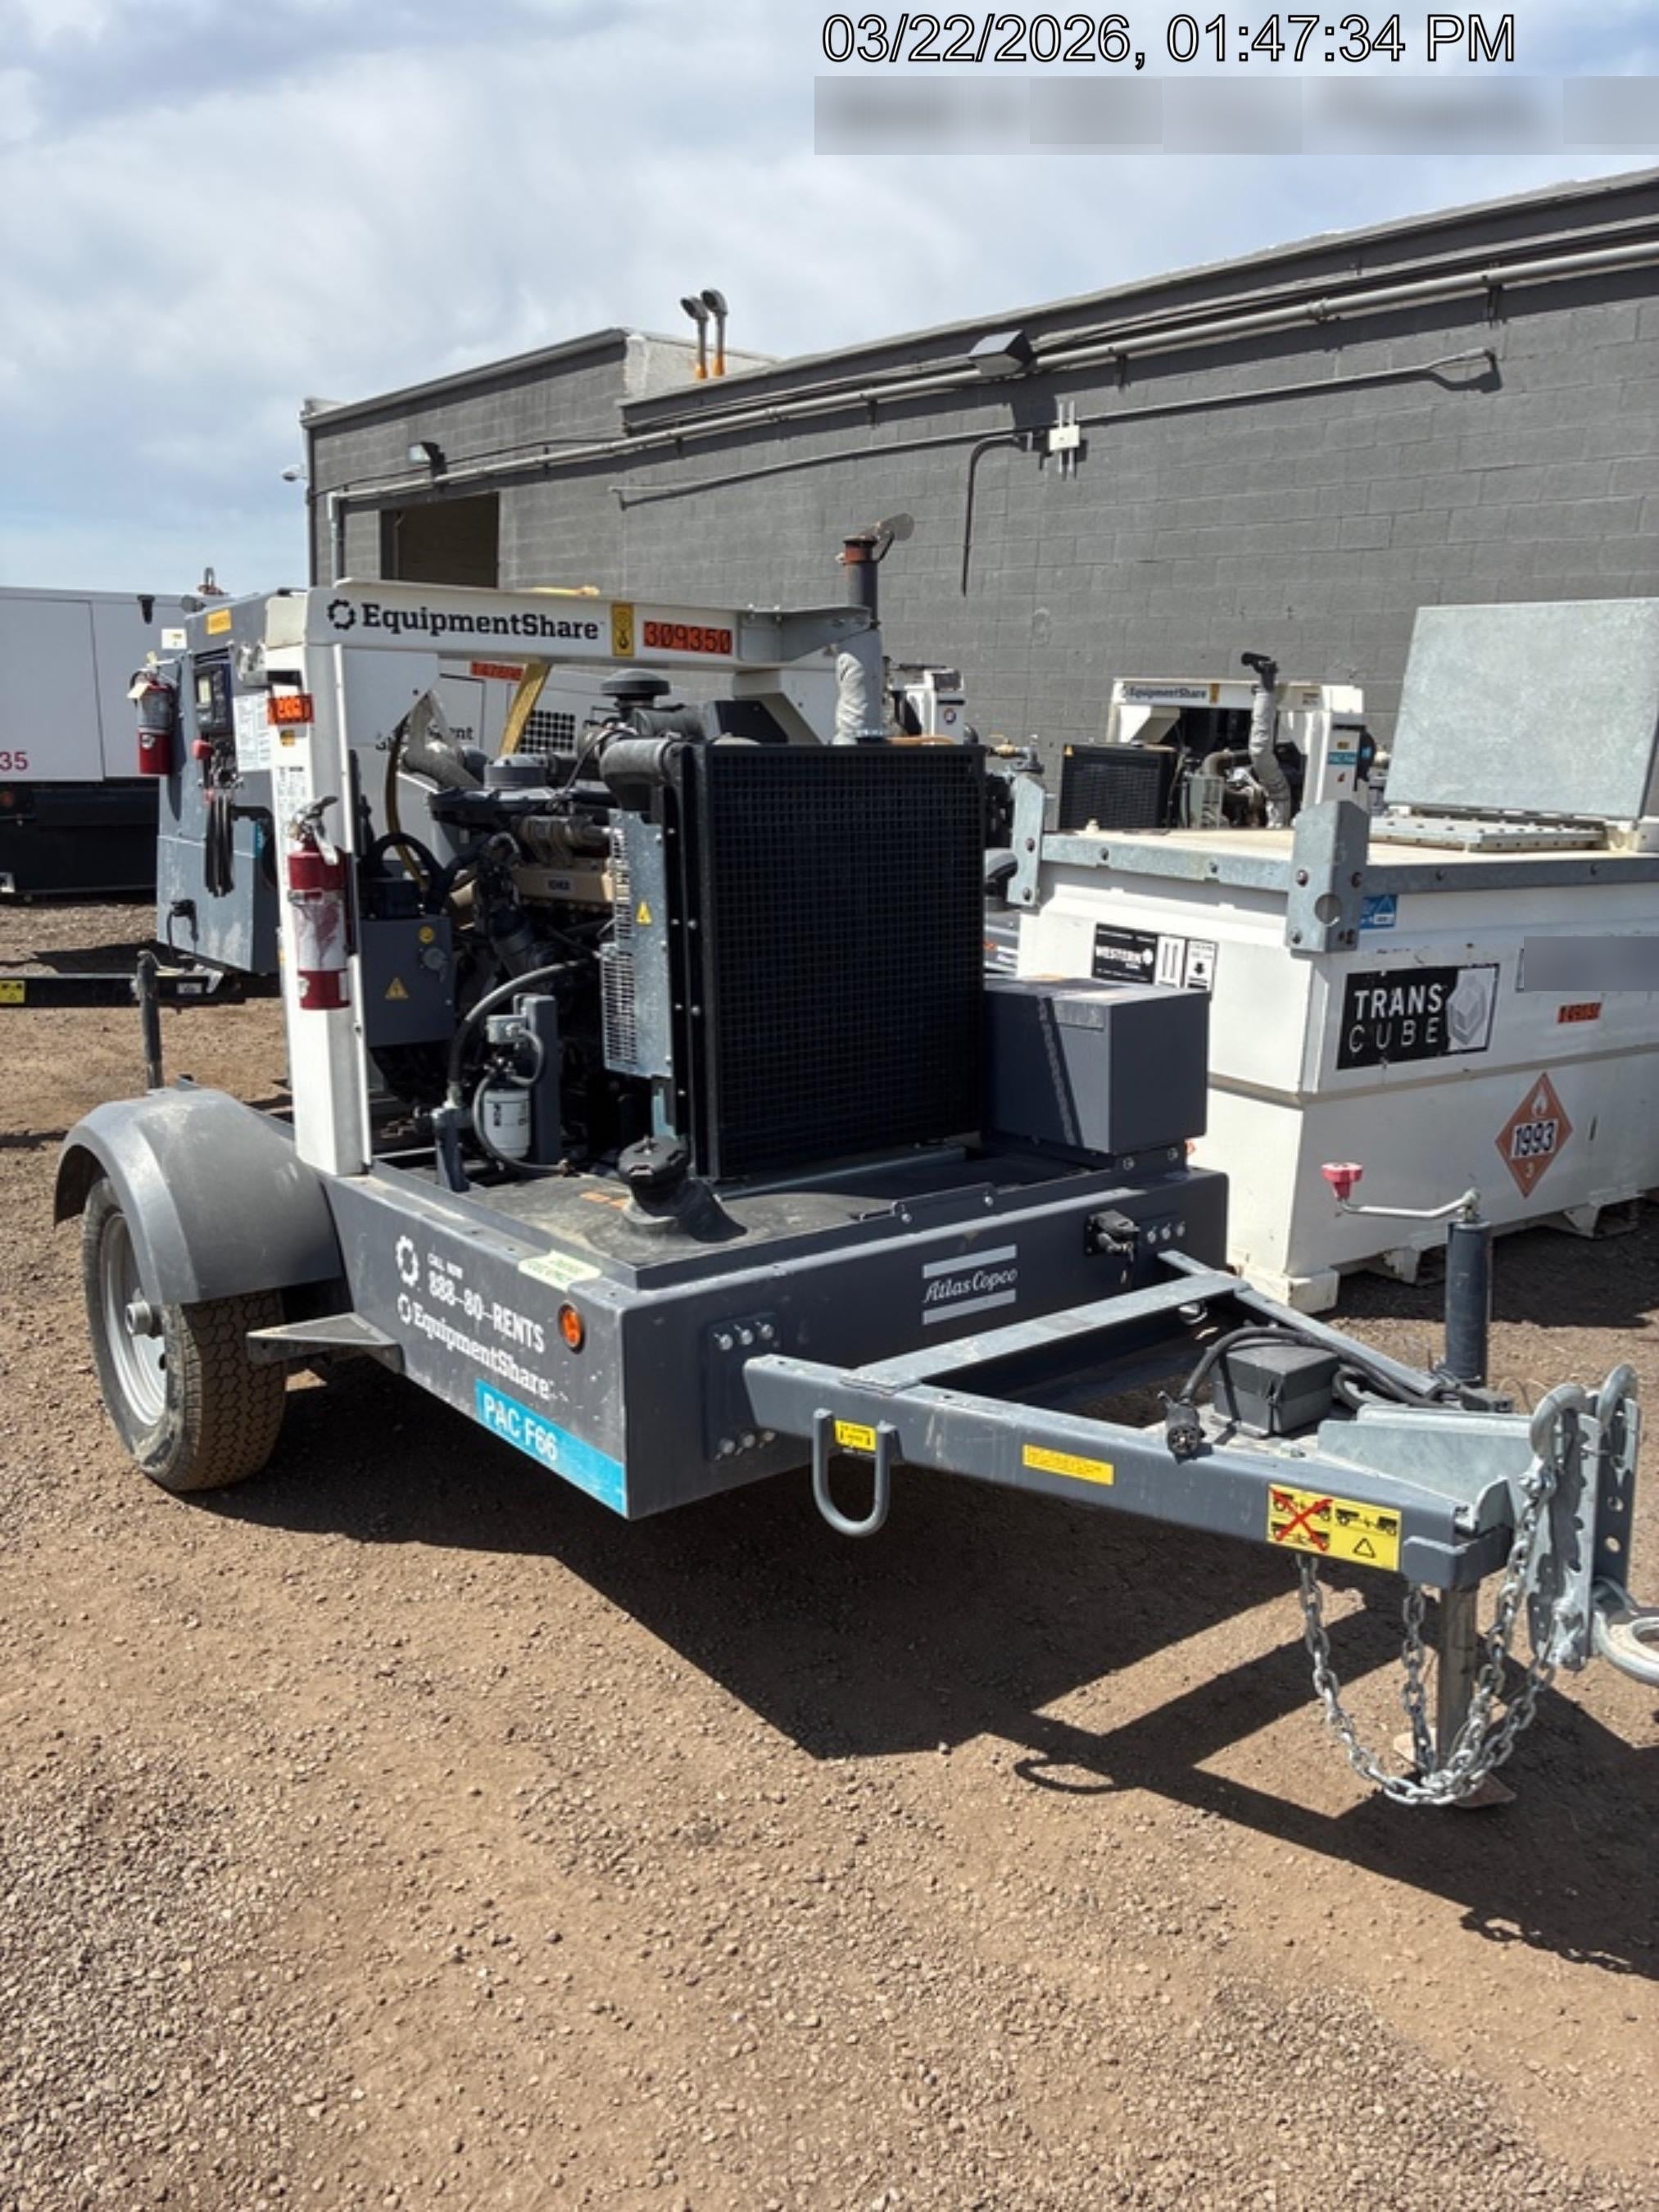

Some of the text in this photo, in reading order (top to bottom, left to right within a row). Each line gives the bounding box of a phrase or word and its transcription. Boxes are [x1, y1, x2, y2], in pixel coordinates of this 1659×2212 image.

[361, 603, 600, 639] EquipmentShare
[643, 620, 732, 655] 309350
[1354, 983, 1444, 1022] TRANS
[1349, 1017, 1441, 1054] CUBE
[1514, 1122, 1555, 1156] 1993
[923, 1268, 1018, 1303] Atlas Copco
[412, 1301, 551, 1400] EquipmentShare
[483, 1393, 558, 1462] PAC F66
